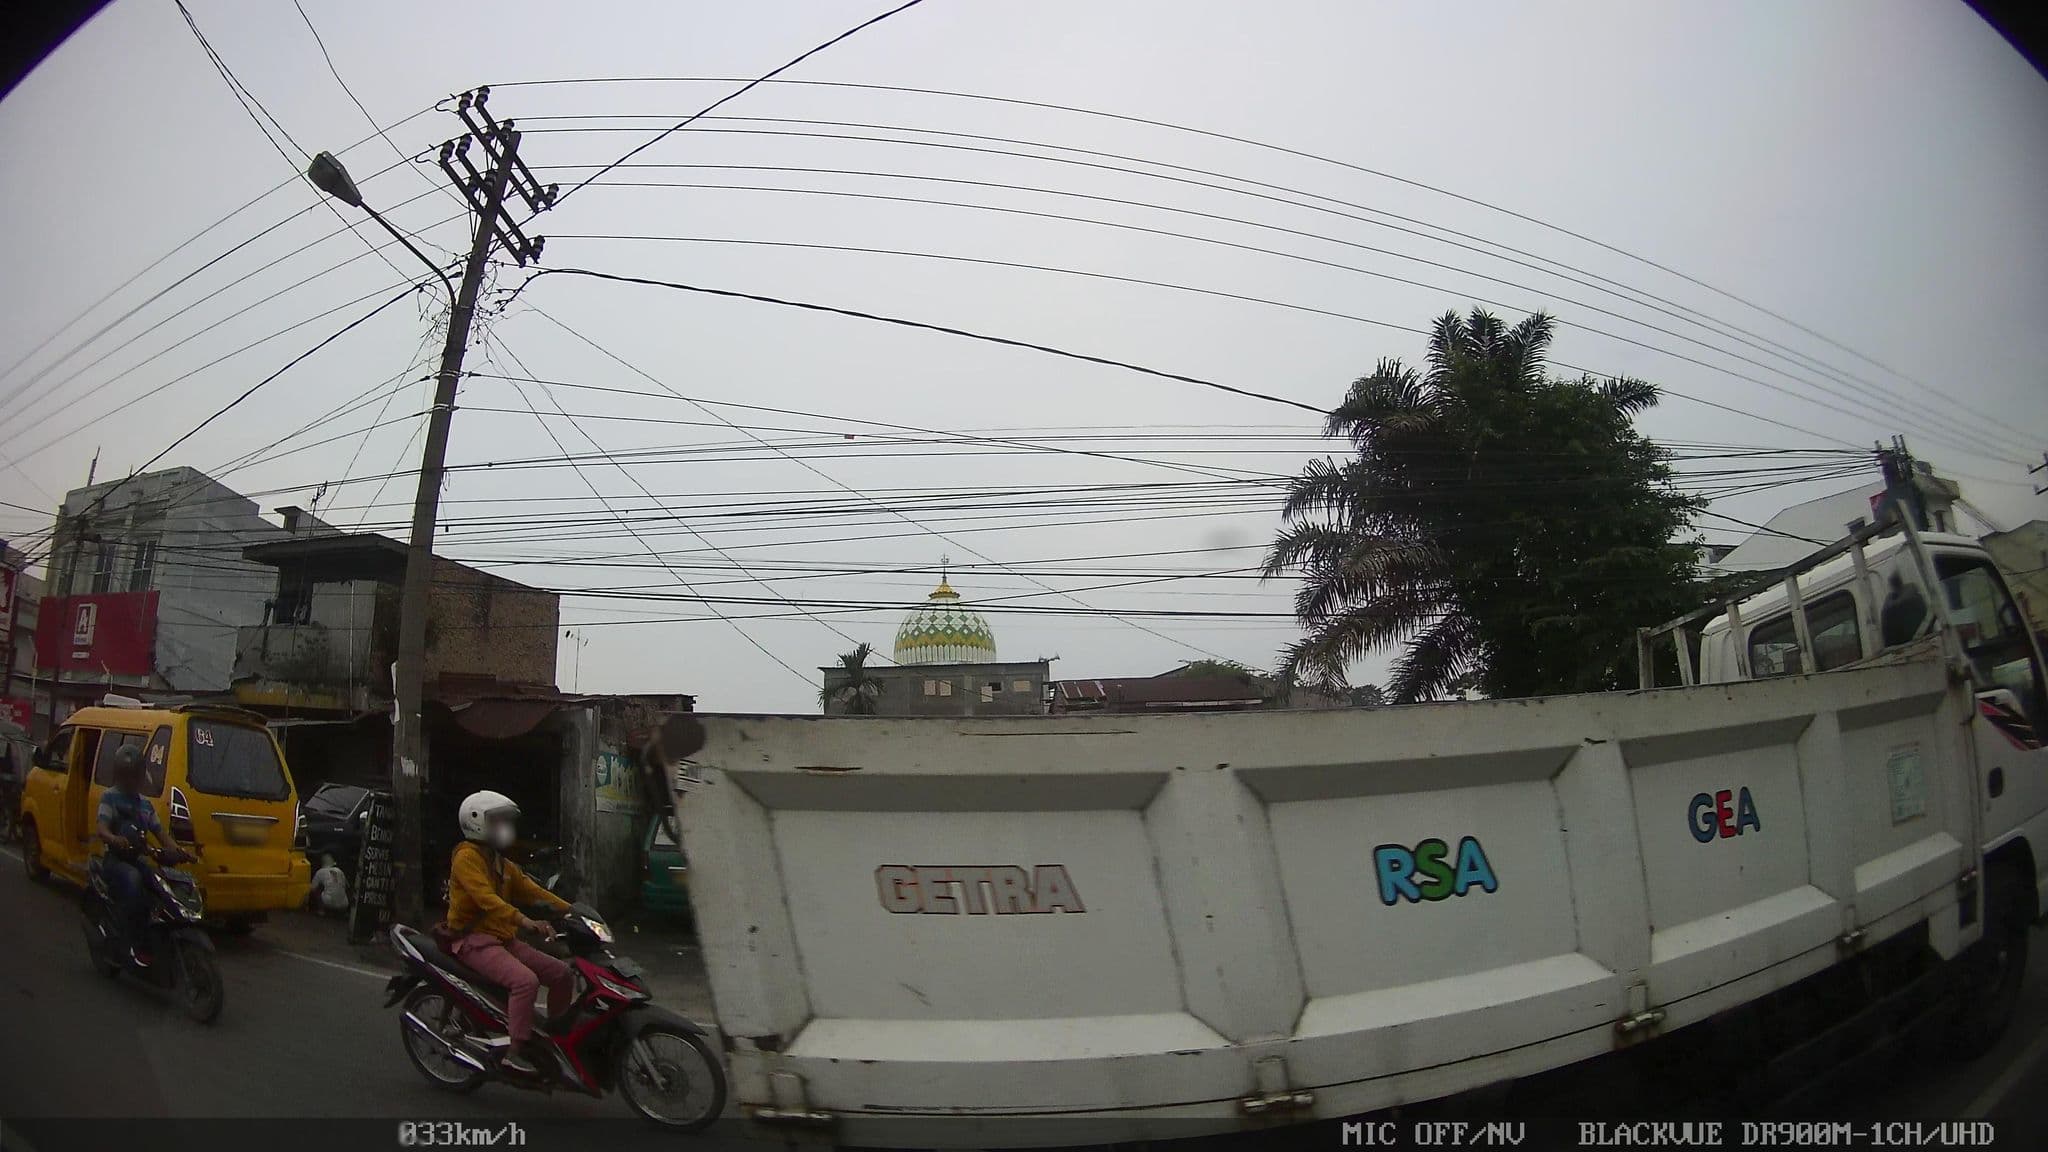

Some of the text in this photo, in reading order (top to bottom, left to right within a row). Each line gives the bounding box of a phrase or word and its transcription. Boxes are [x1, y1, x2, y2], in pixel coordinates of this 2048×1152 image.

[1688, 786, 1761, 843] GEA
[874, 864, 1087, 915] GETRA
[1373, 836, 1498, 906] RSA
